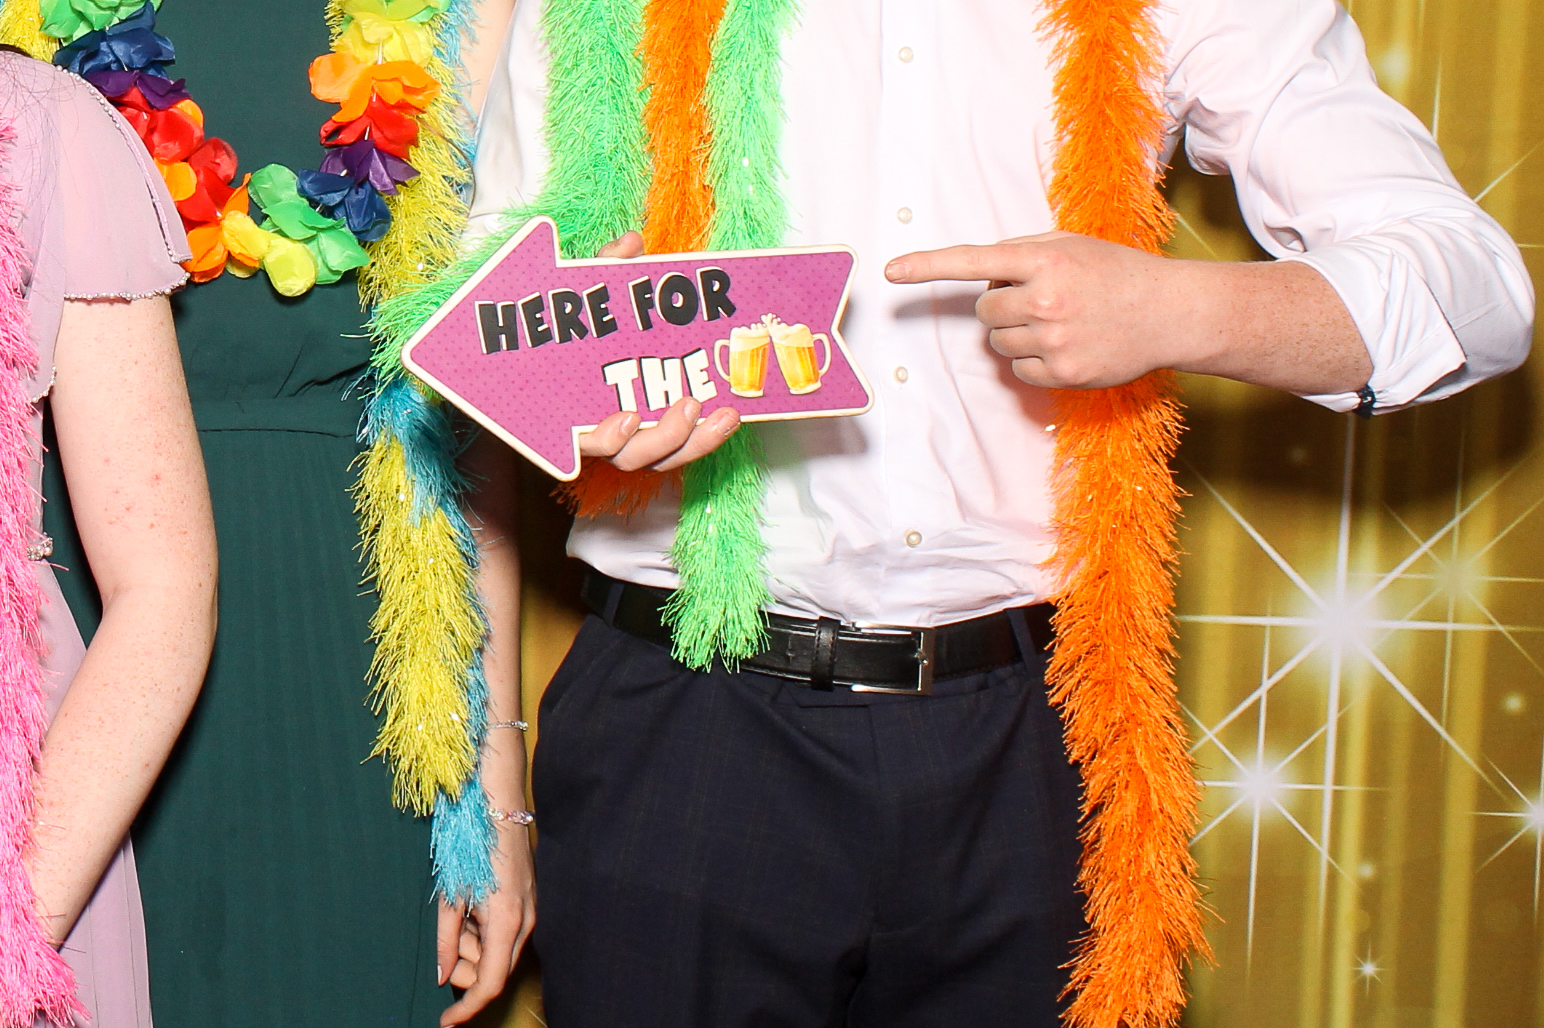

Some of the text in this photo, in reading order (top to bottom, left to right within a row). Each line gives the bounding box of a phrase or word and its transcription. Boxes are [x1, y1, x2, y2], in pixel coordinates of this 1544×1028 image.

[475, 266, 737, 355] HERE FOR
[601, 348, 718, 412] THE
